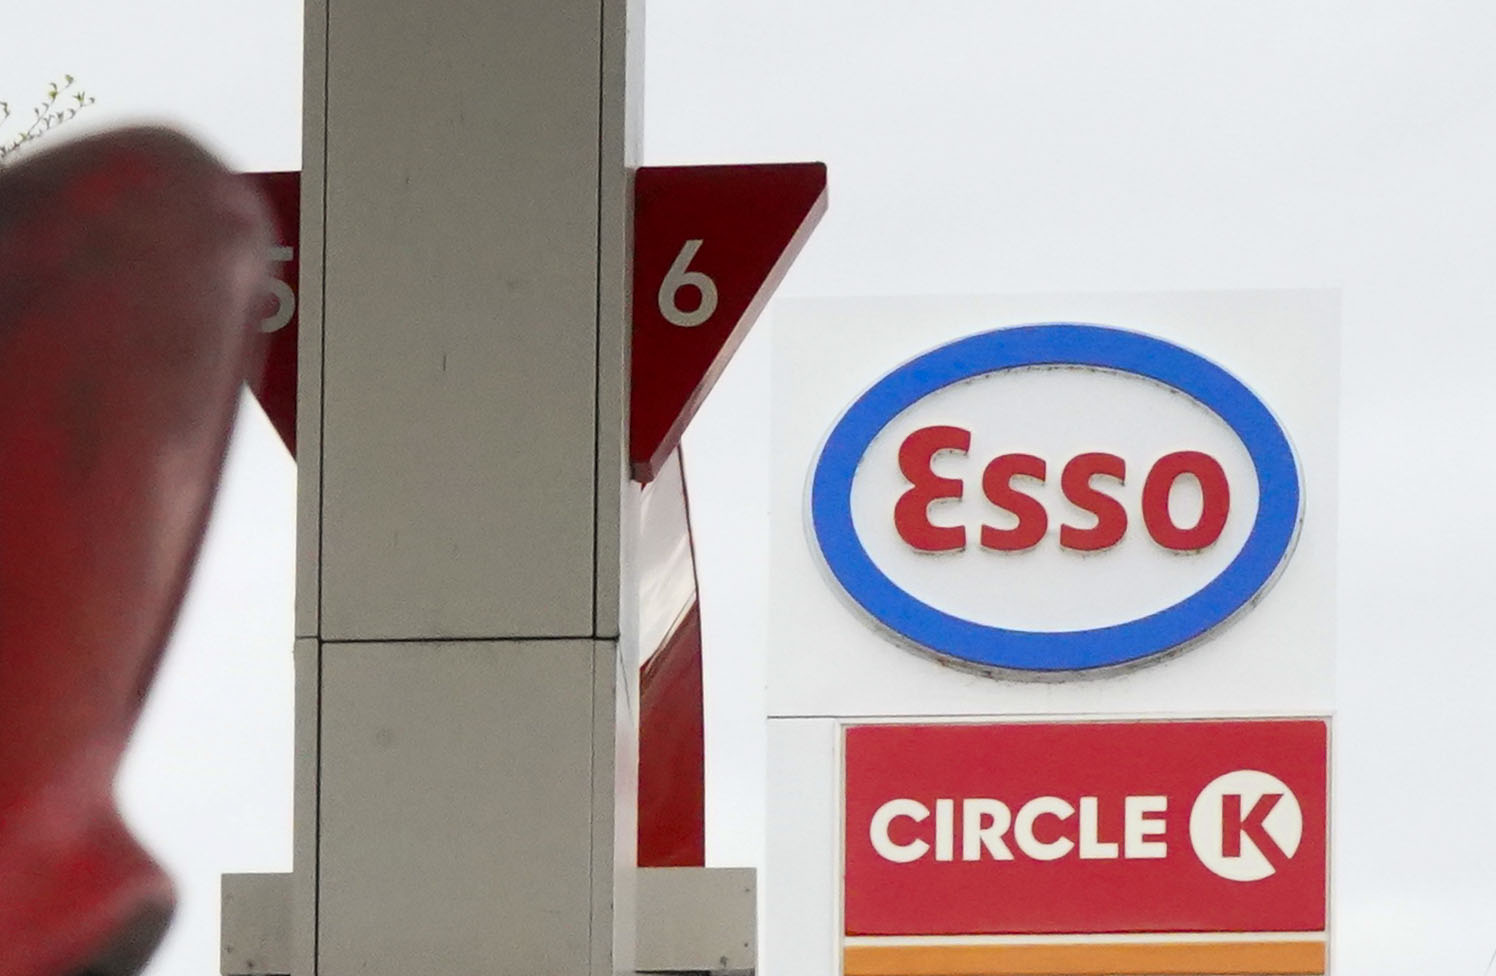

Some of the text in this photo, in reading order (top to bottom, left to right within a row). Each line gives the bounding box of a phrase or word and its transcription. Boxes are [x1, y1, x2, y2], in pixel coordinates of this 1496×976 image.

[657, 239, 719, 327] 6
[893, 425, 1231, 553] Esso
[869, 793, 1289, 864] CIRCLE K
